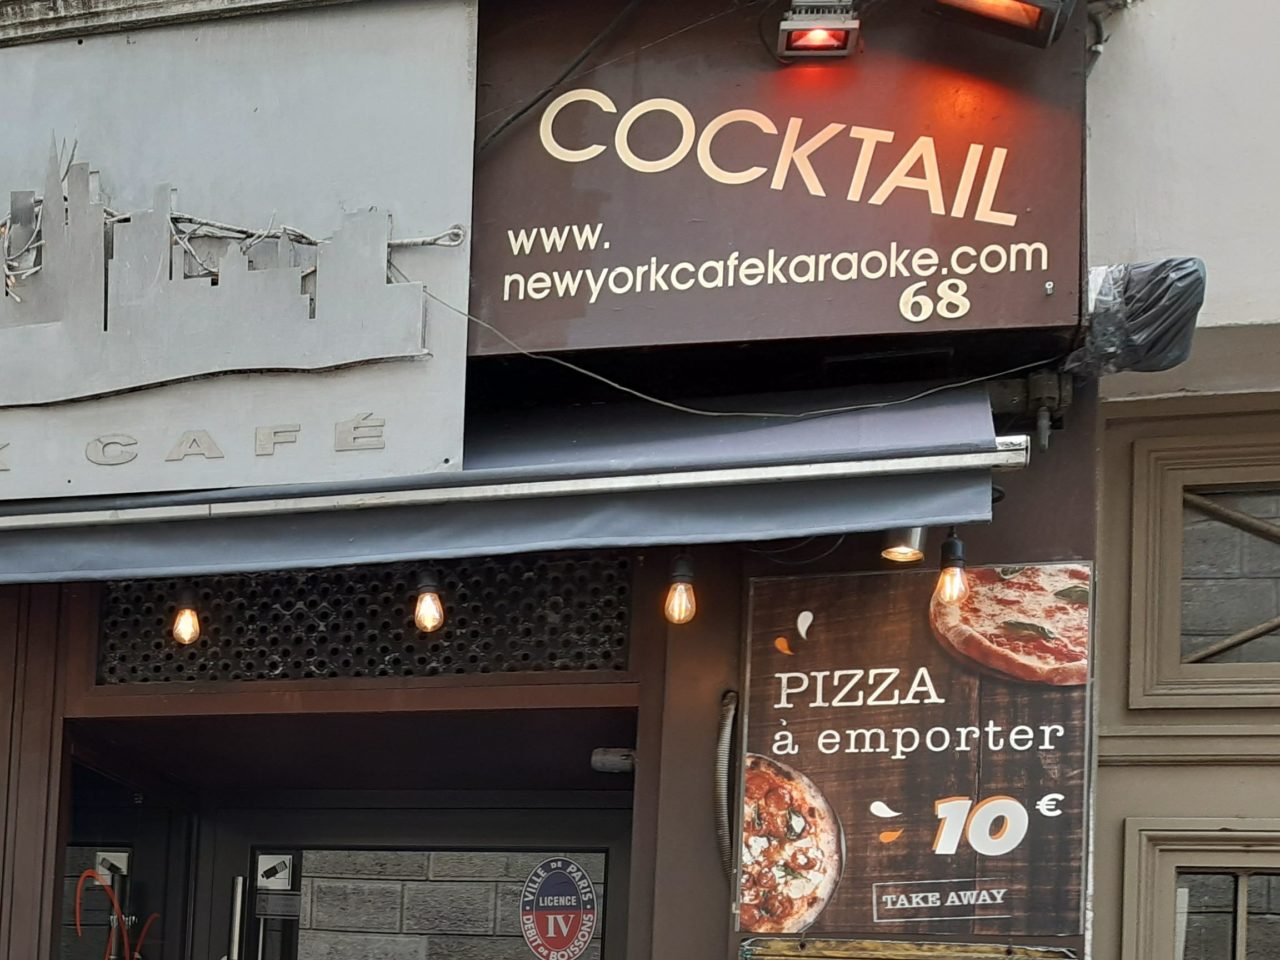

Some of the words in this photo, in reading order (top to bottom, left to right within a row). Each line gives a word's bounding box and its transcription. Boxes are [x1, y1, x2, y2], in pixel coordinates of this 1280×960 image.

[539, 88, 1018, 227] COCKTAIL
[507, 222, 611, 256] www.
[503, 241, 1048, 303] newyorkcafekaraoke.com
[899, 278, 971, 322] 68
[85, 412, 386, 466] CAFÉ
[773, 667, 945, 709] PIZZA
[772, 719, 799, 756] à
[818, 719, 1065, 759] emporter
[523, 867, 548, 902] VILLE
[550, 861, 562, 869] DE
[566, 864, 593, 901] PARIS
[539, 895, 577, 907] LICENCE
[883, 892, 941, 910] TAKE
[945, 888, 1009, 909] AWAY
[523, 914, 543, 947] DEBIT
[548, 913, 594, 960] BOISSONS
[546, 914, 576, 938] IV
